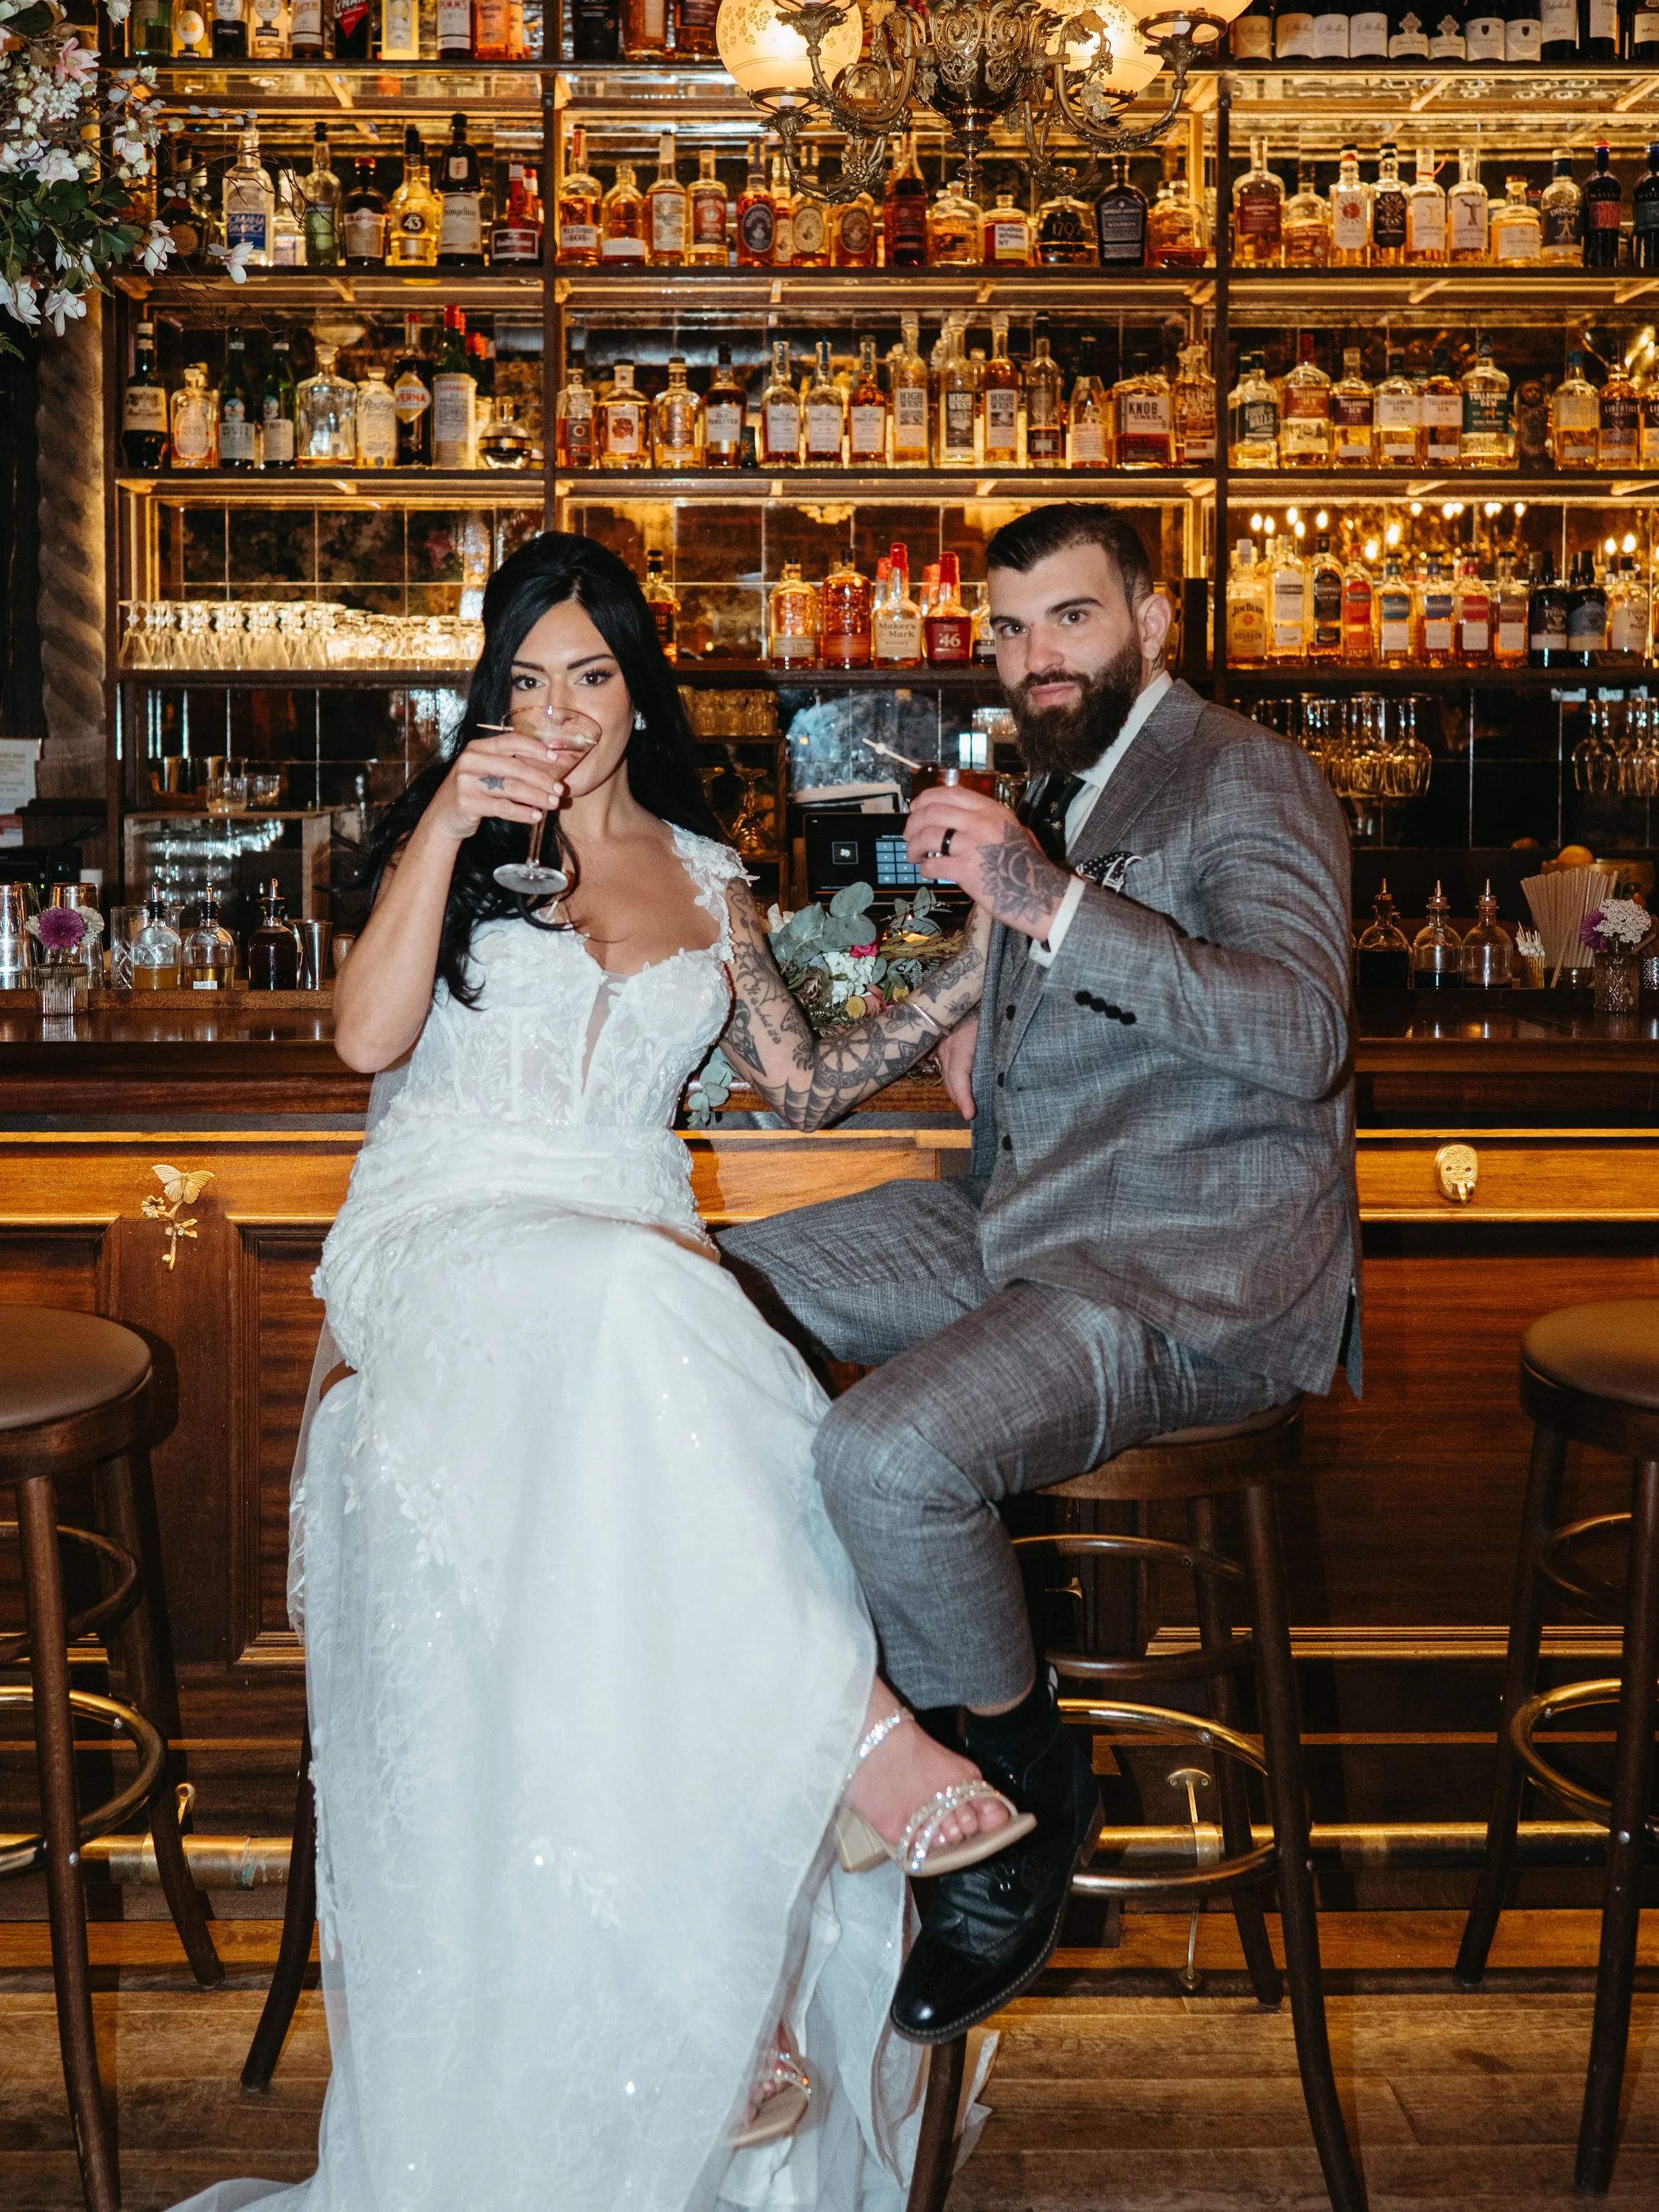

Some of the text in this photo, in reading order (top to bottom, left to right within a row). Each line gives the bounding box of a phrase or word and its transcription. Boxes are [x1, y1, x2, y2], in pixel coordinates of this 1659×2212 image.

[403, 216, 422, 230] 43
[1129, 402, 1157, 415] KNOB
[1232, 605, 1245, 617] JIM
